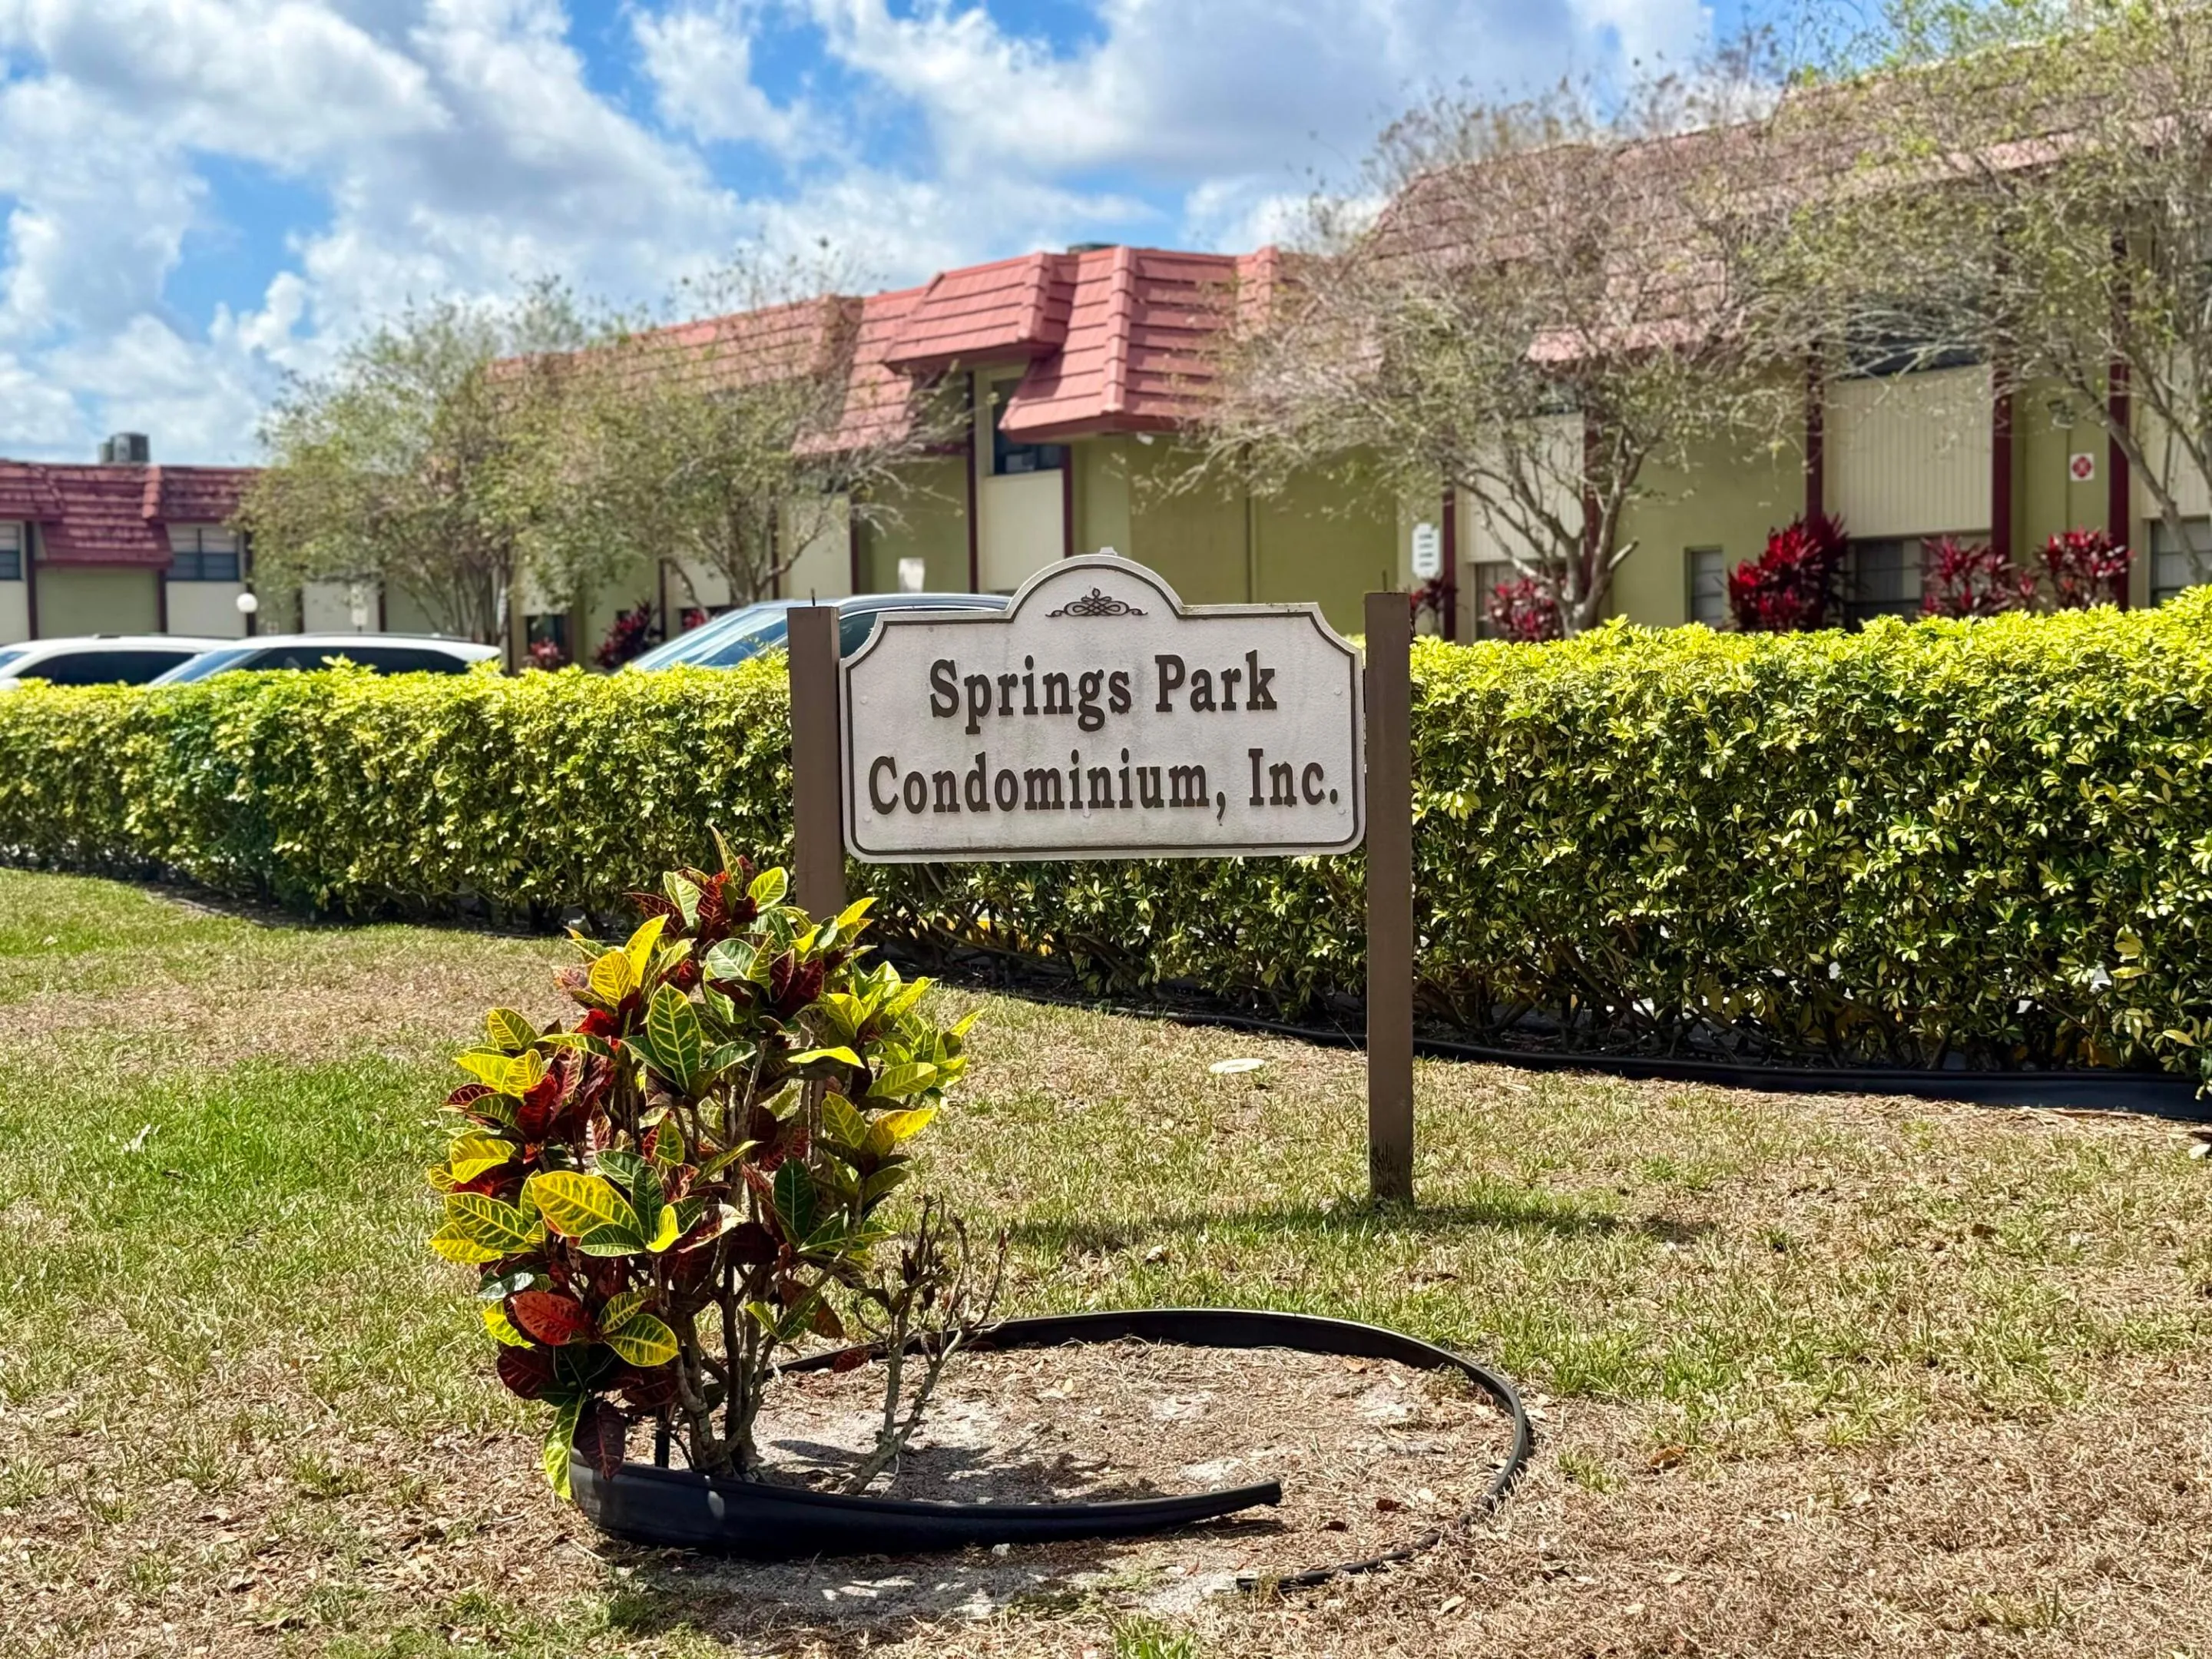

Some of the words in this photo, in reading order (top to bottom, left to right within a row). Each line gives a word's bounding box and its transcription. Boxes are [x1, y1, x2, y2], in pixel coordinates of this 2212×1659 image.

[929, 655, 1132, 734] Springs
[1154, 650, 1278, 713] Park
[869, 748, 1227, 824] Condominium,
[1248, 747, 1339, 807] Inc.
